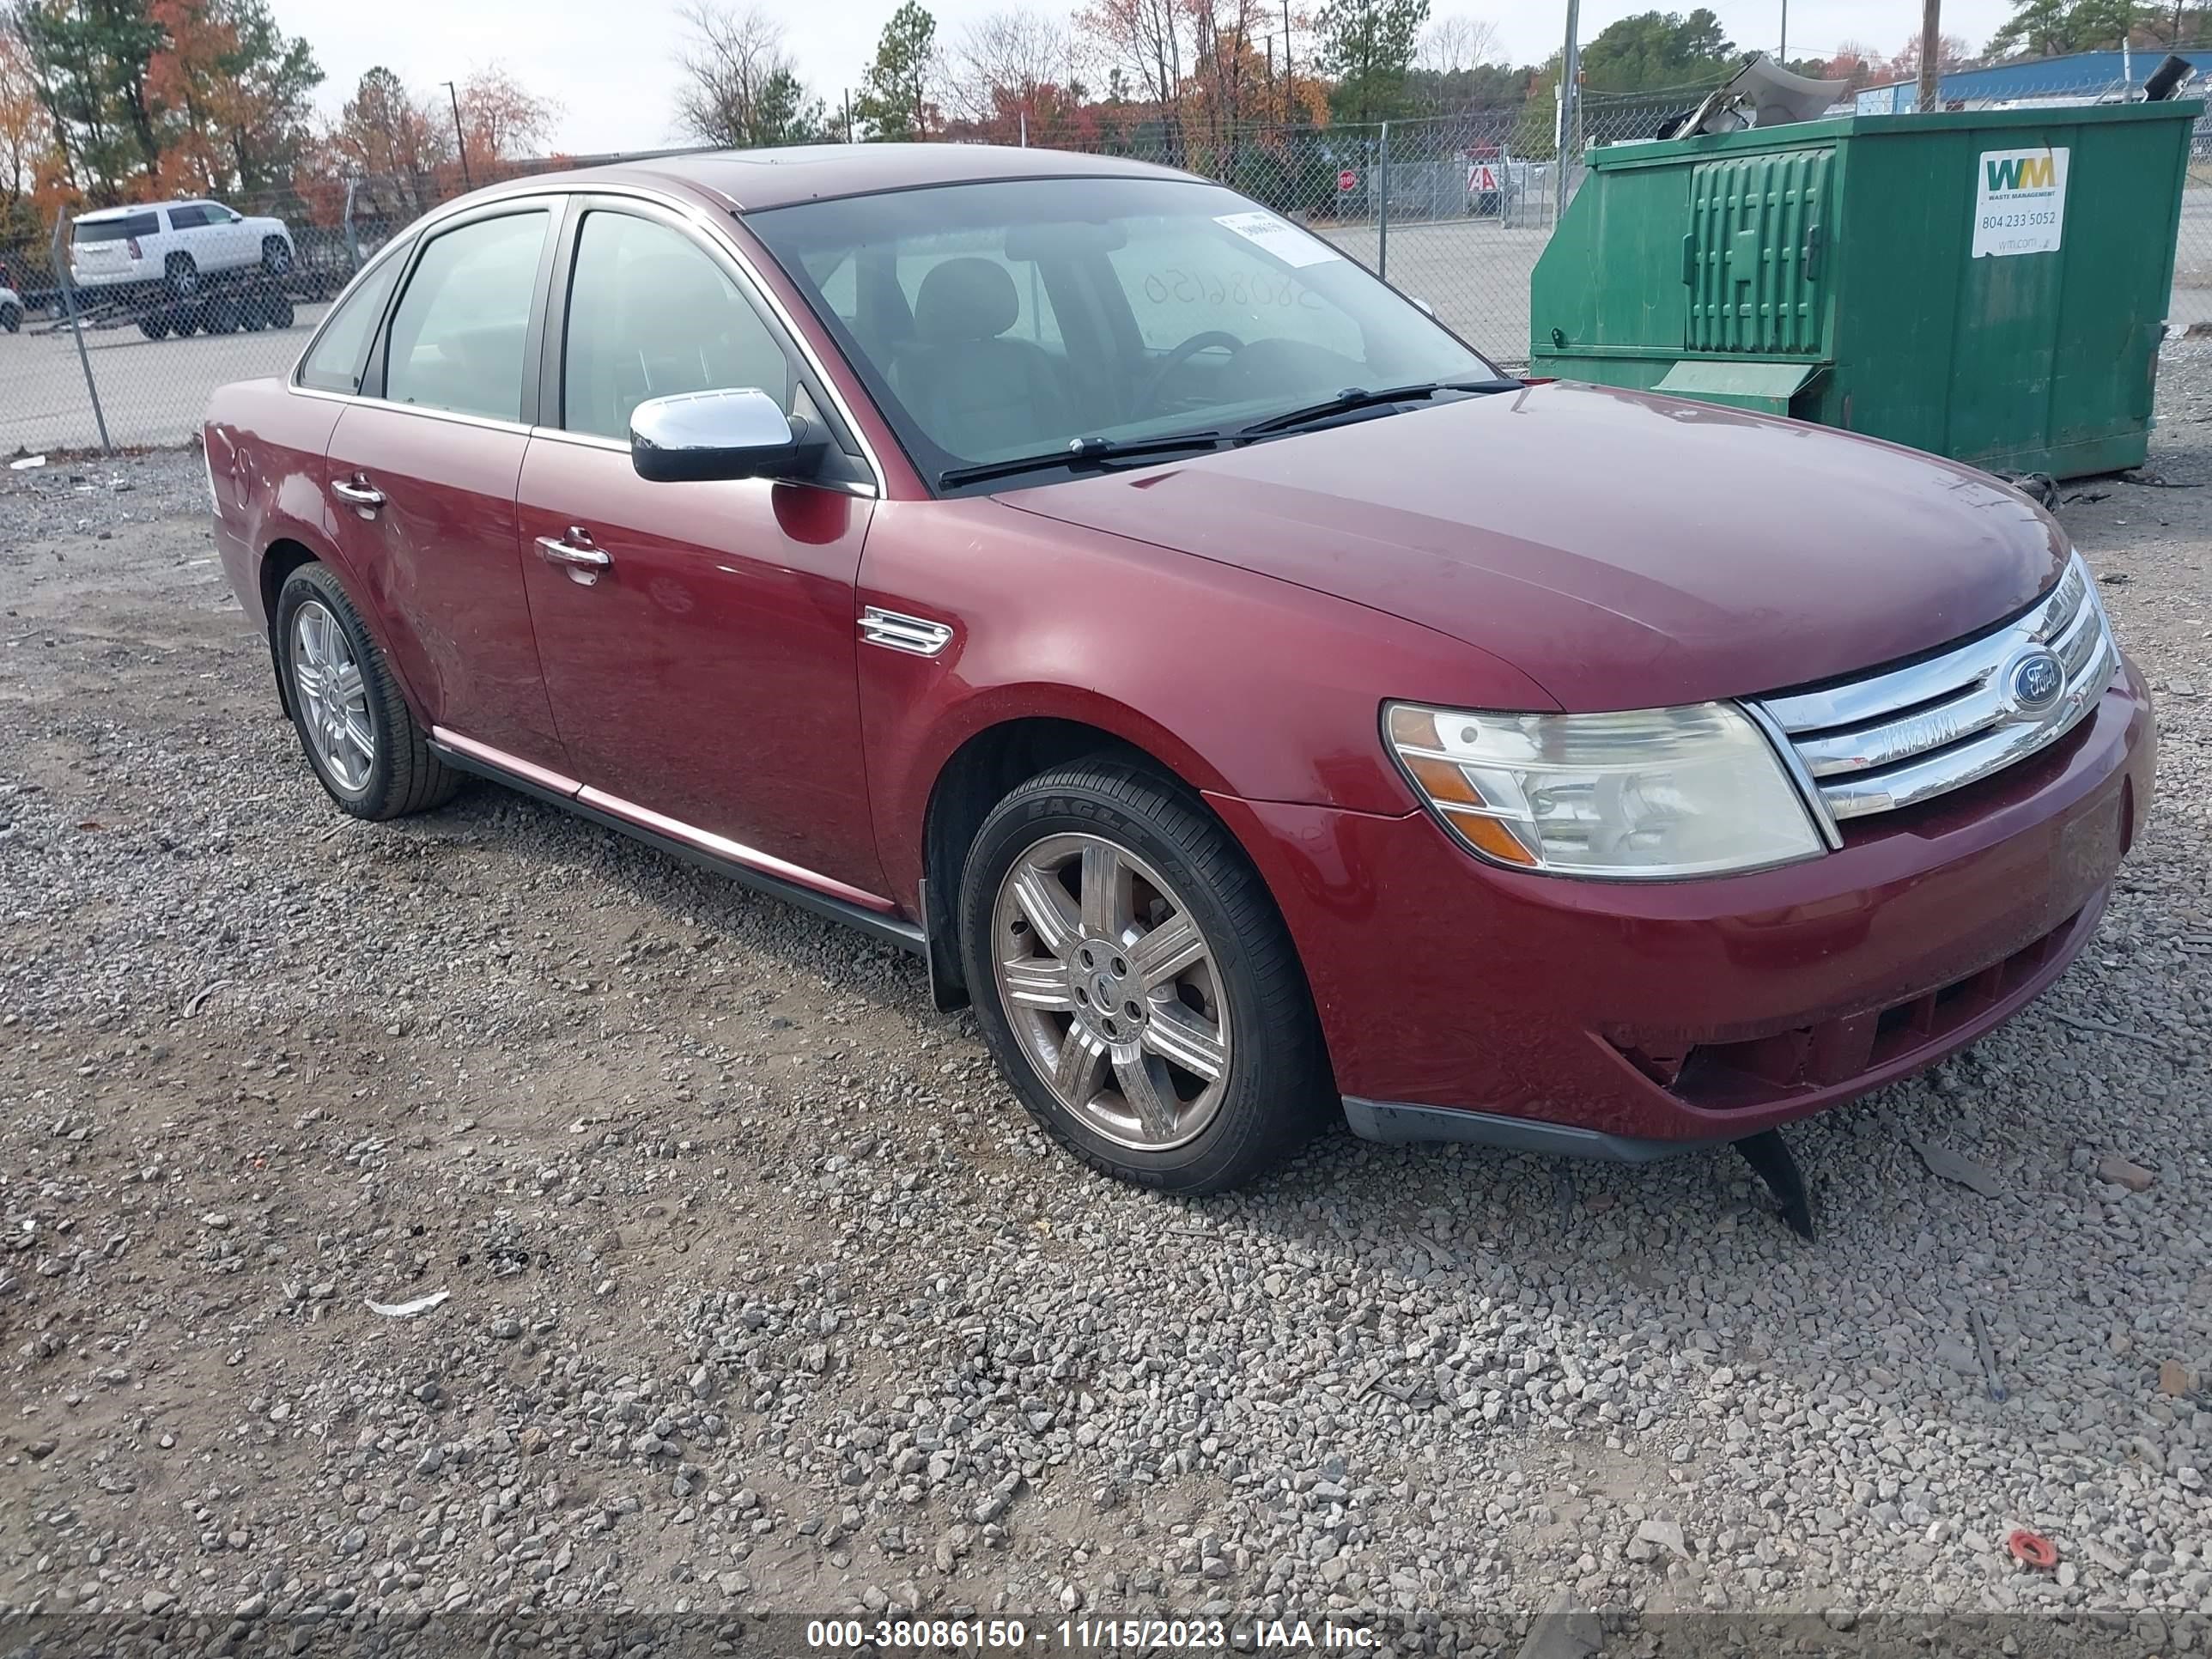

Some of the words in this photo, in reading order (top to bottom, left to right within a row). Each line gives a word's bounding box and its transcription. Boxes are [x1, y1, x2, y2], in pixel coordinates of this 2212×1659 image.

[1340, 175, 1355, 185] STOP
[1987, 157, 2056, 191] WM
[1982, 216, 2003, 229] 804
[2006, 214, 2027, 227] 233
[2029, 212, 2056, 226] 5052
[2027, 663, 2057, 697] Ford
[1027, 796, 1151, 844] EAGLE
